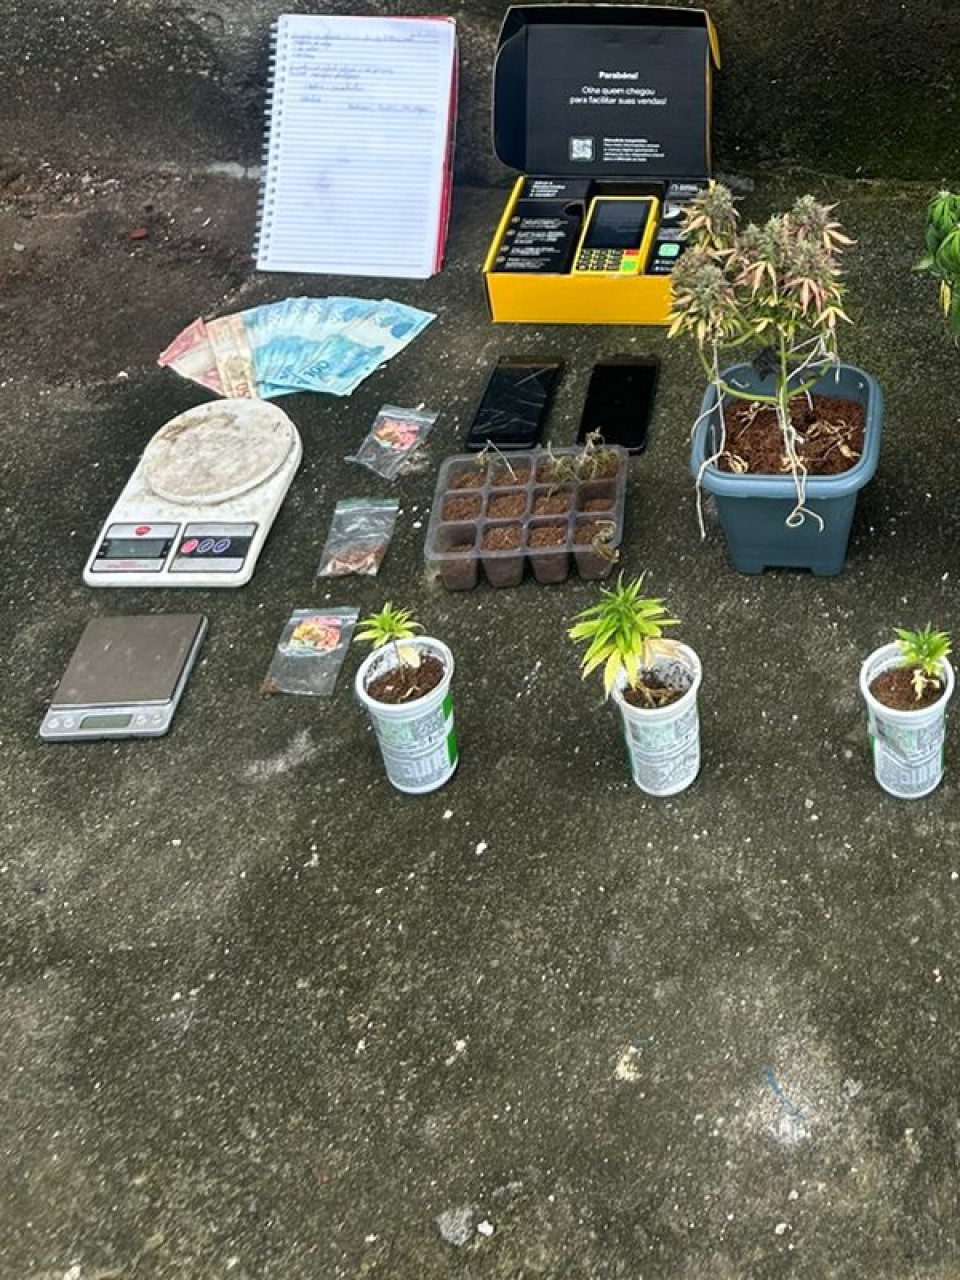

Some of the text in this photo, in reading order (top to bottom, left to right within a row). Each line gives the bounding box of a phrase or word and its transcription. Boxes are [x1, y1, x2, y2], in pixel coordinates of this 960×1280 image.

[582, 86, 656, 97] Olha quem chegou
[570, 97, 587, 105] para
[588, 96, 616, 105] facilitar
[303, 360, 329, 378] 100
